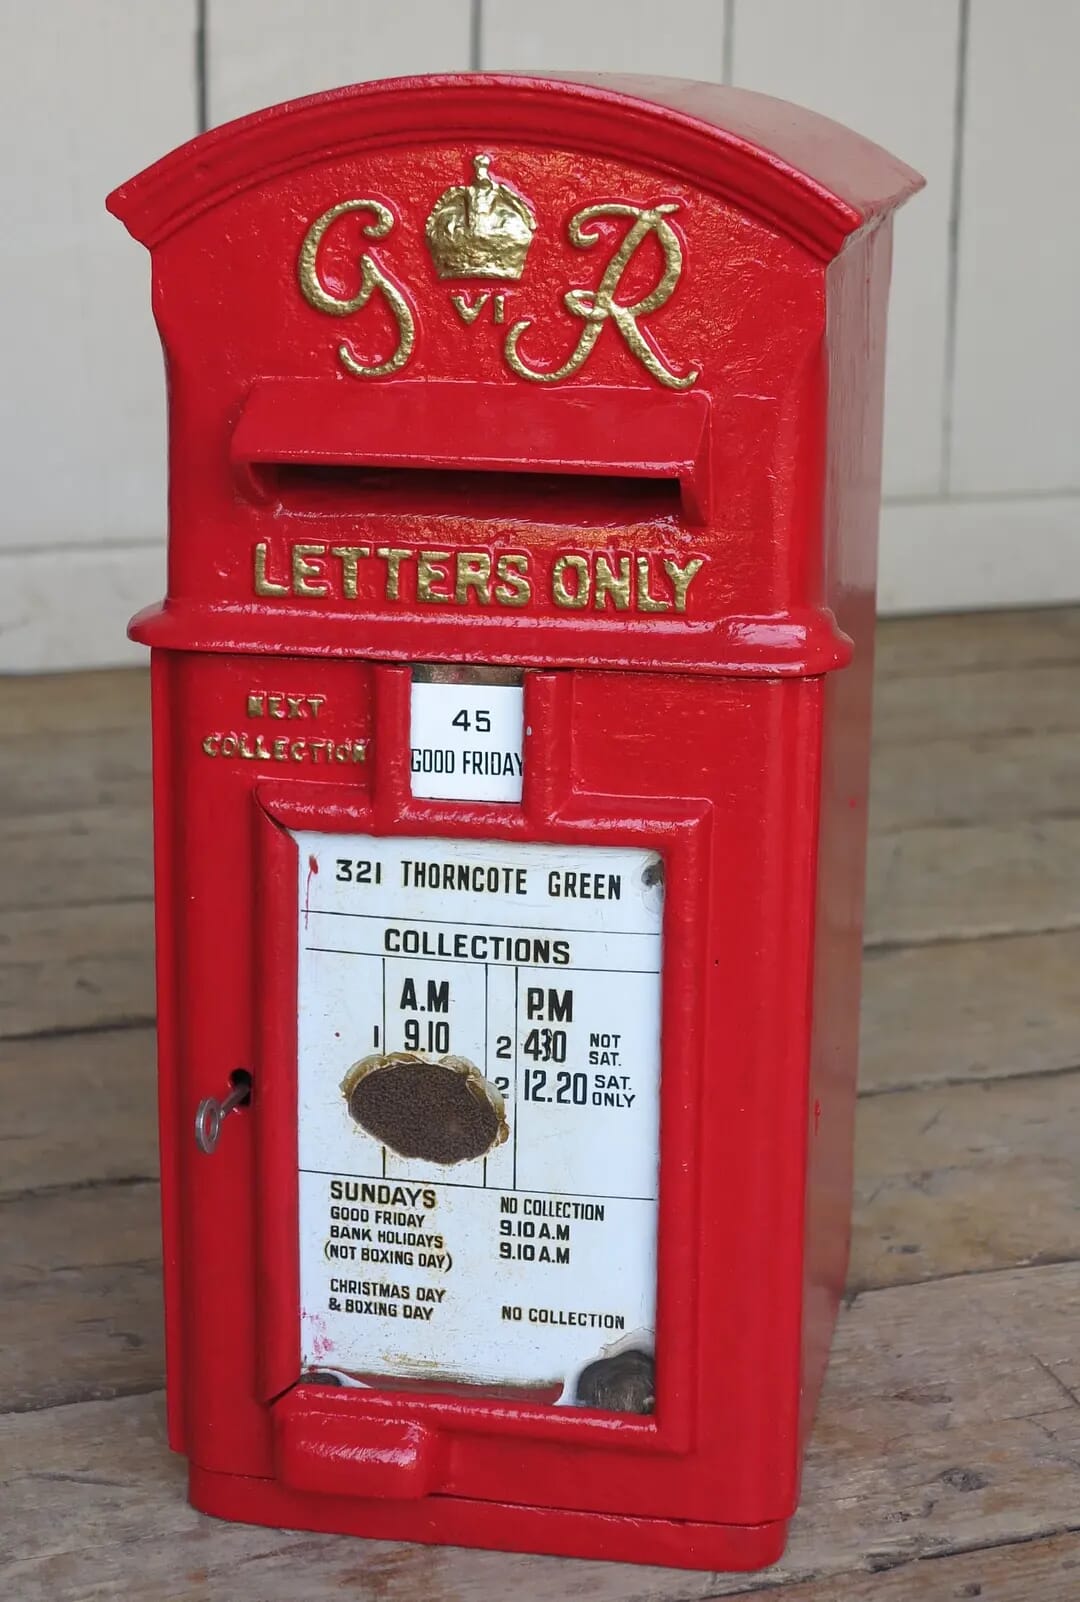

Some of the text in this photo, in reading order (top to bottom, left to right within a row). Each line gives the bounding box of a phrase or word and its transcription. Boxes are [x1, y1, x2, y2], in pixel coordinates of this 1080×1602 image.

[300, 199, 699, 390] G VI R
[253, 542, 704, 614] LETTERS ONLY
[247, 695, 325, 719] NEXT
[451, 709, 491, 733] 45
[203, 734, 367, 764] COLLECTION
[410, 748, 523, 777] GOOD FRIDAY
[335, 858, 622, 901] 321 THORNCOTE GREEN
[384, 928, 571, 965] COLLECTIONS
[400, 977, 450, 1014] A.M
[527, 987, 573, 1023] P.M
[403, 1018, 450, 1054] 9.10
[496, 1035, 512, 1060] 2
[589, 1033, 621, 1049] NOT
[588, 1050, 622, 1067] SAT.
[494, 1068, 588, 1106] 2 12.20
[594, 1073, 632, 1092] SAT.
[592, 1091, 636, 1109] ONLY
[330, 1180, 437, 1209] SUNDAYS
[330, 1205, 426, 1229] GOOD FRIDAY
[500, 1196, 605, 1222] NO COLLECTION
[330, 1224, 444, 1250] BANK HOLIDAYS
[499, 1219, 535, 1238] 9.10
[324, 1239, 453, 1273] (NOT BOXING DAY)
[499, 1242, 535, 1261] 9.10
[330, 1278, 447, 1304] CHRISTMAS DAY
[328, 1297, 434, 1321] & BOXING DAY
[501, 1305, 626, 1330] NO COLLECTION
